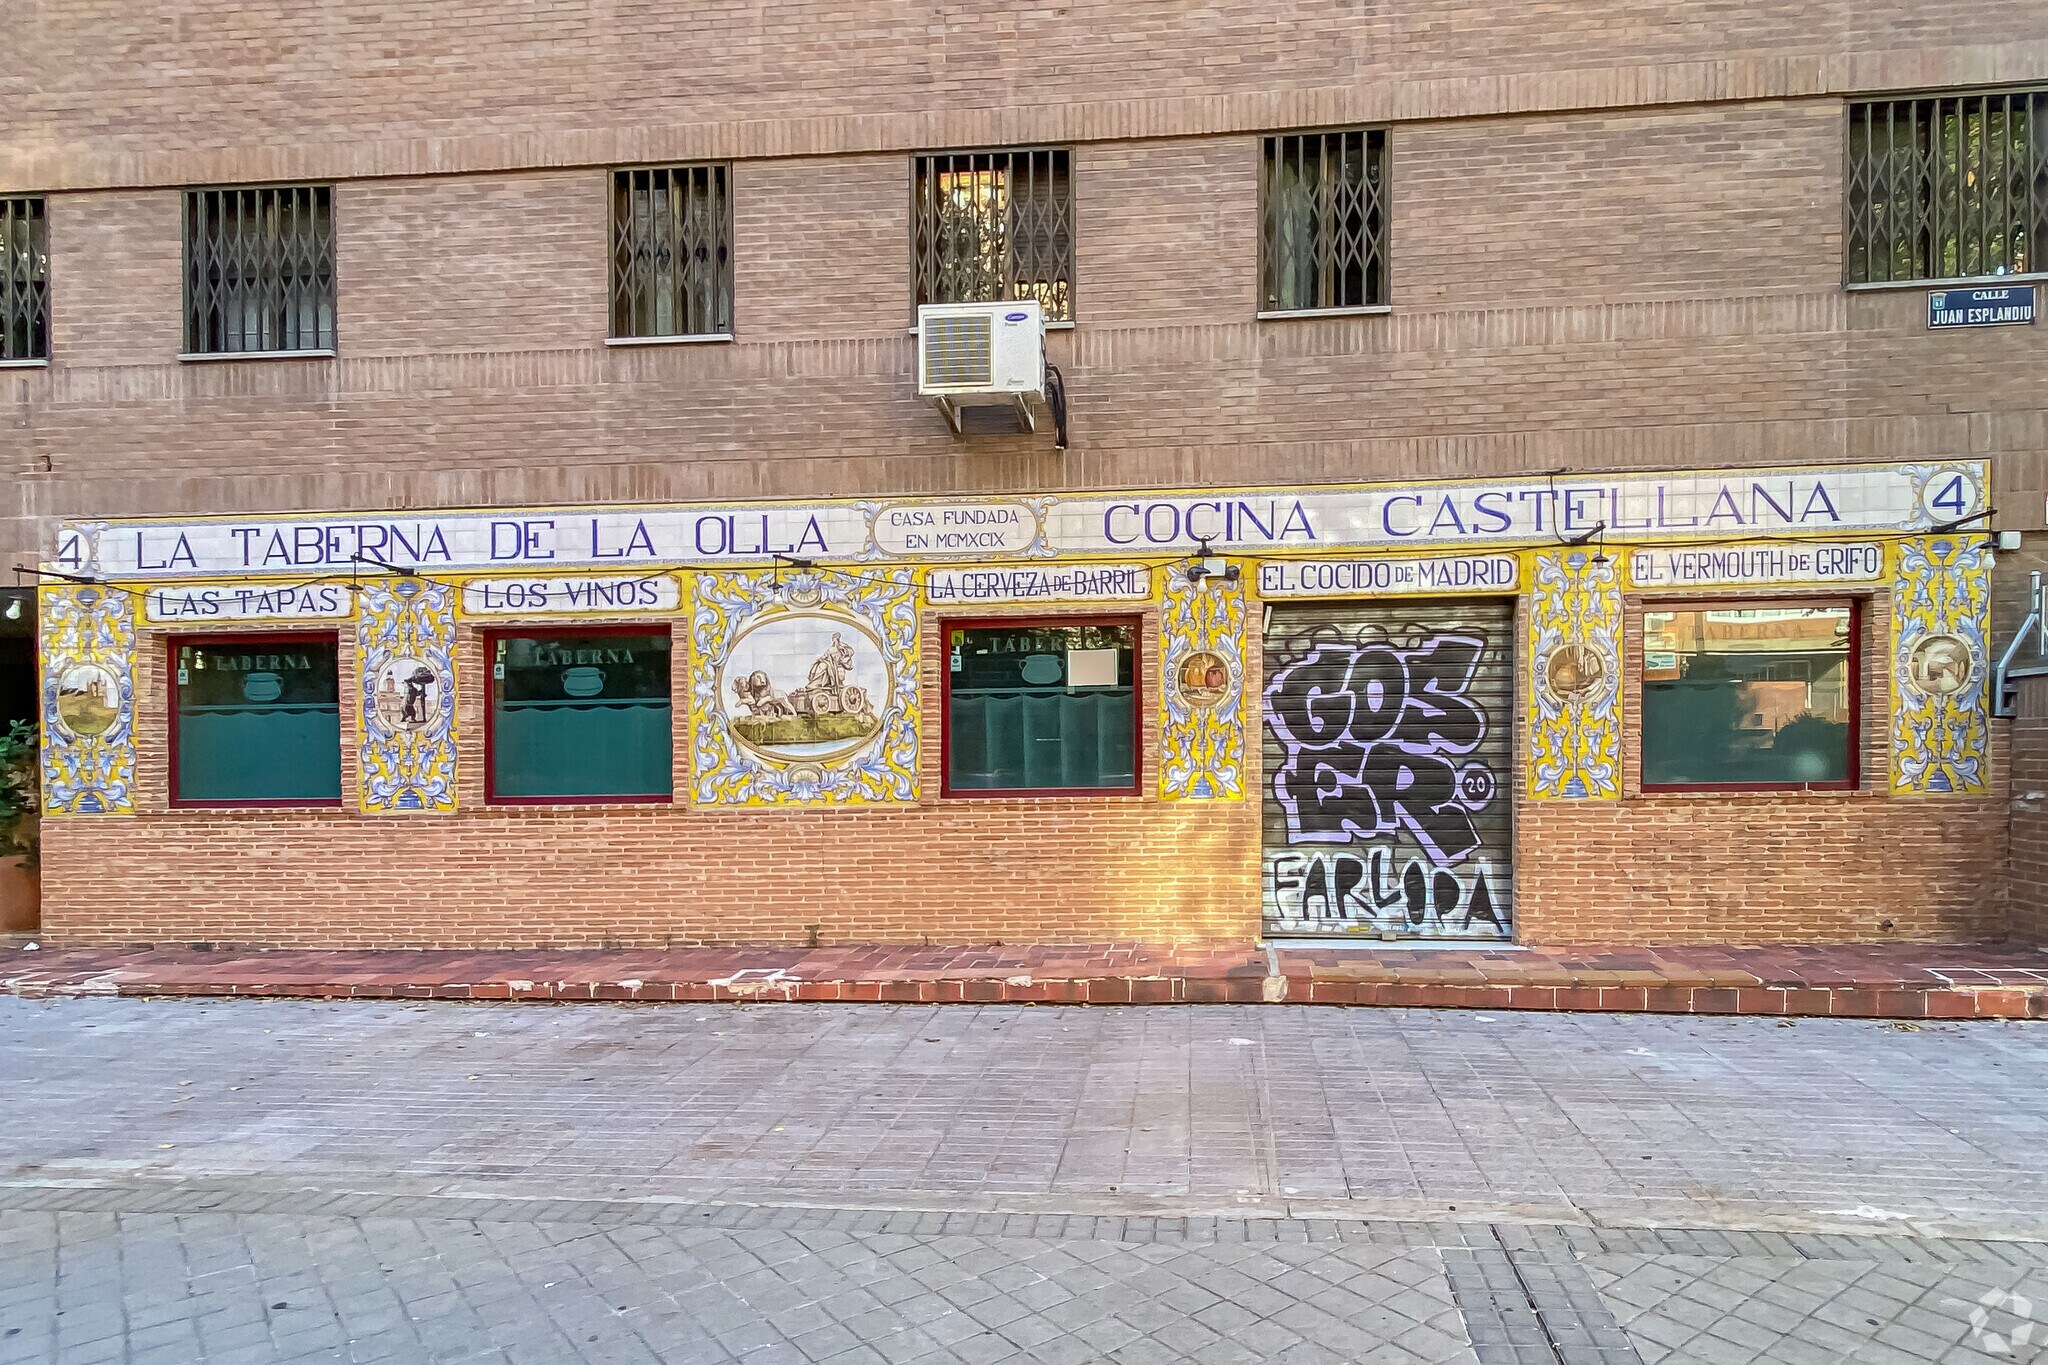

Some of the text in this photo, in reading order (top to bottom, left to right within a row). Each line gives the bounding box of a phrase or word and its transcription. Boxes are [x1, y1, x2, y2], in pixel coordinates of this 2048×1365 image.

[1972, 289, 2010, 301] CALLE
[1932, 305, 2032, 325] JUAN ESPLANDIU
[1932, 475, 1966, 516] 4
[891, 509, 1019, 526] CASA FUNDADA
[1103, 480, 1841, 545] COCINA CASTELLANA
[58, 534, 82, 570] 4
[136, 513, 830, 570] LA TABERNA DE LA OLLA
[906, 532, 1006, 549] EN MCMXCIX
[1262, 558, 1514, 591] EL COCIDO DE MADRID
[1635, 547, 1878, 581] EL VERMOUTH DE GRIFO
[484, 580, 659, 609] LOS VINOS
[930, 569, 1146, 599] LA CERVEZA DE BARRIL
[159, 587, 338, 616] LAS TAPAS
[214, 654, 311, 671] TABERNA
[535, 648, 635, 666] TABERNA
[1464, 776, 1486, 794] 20
